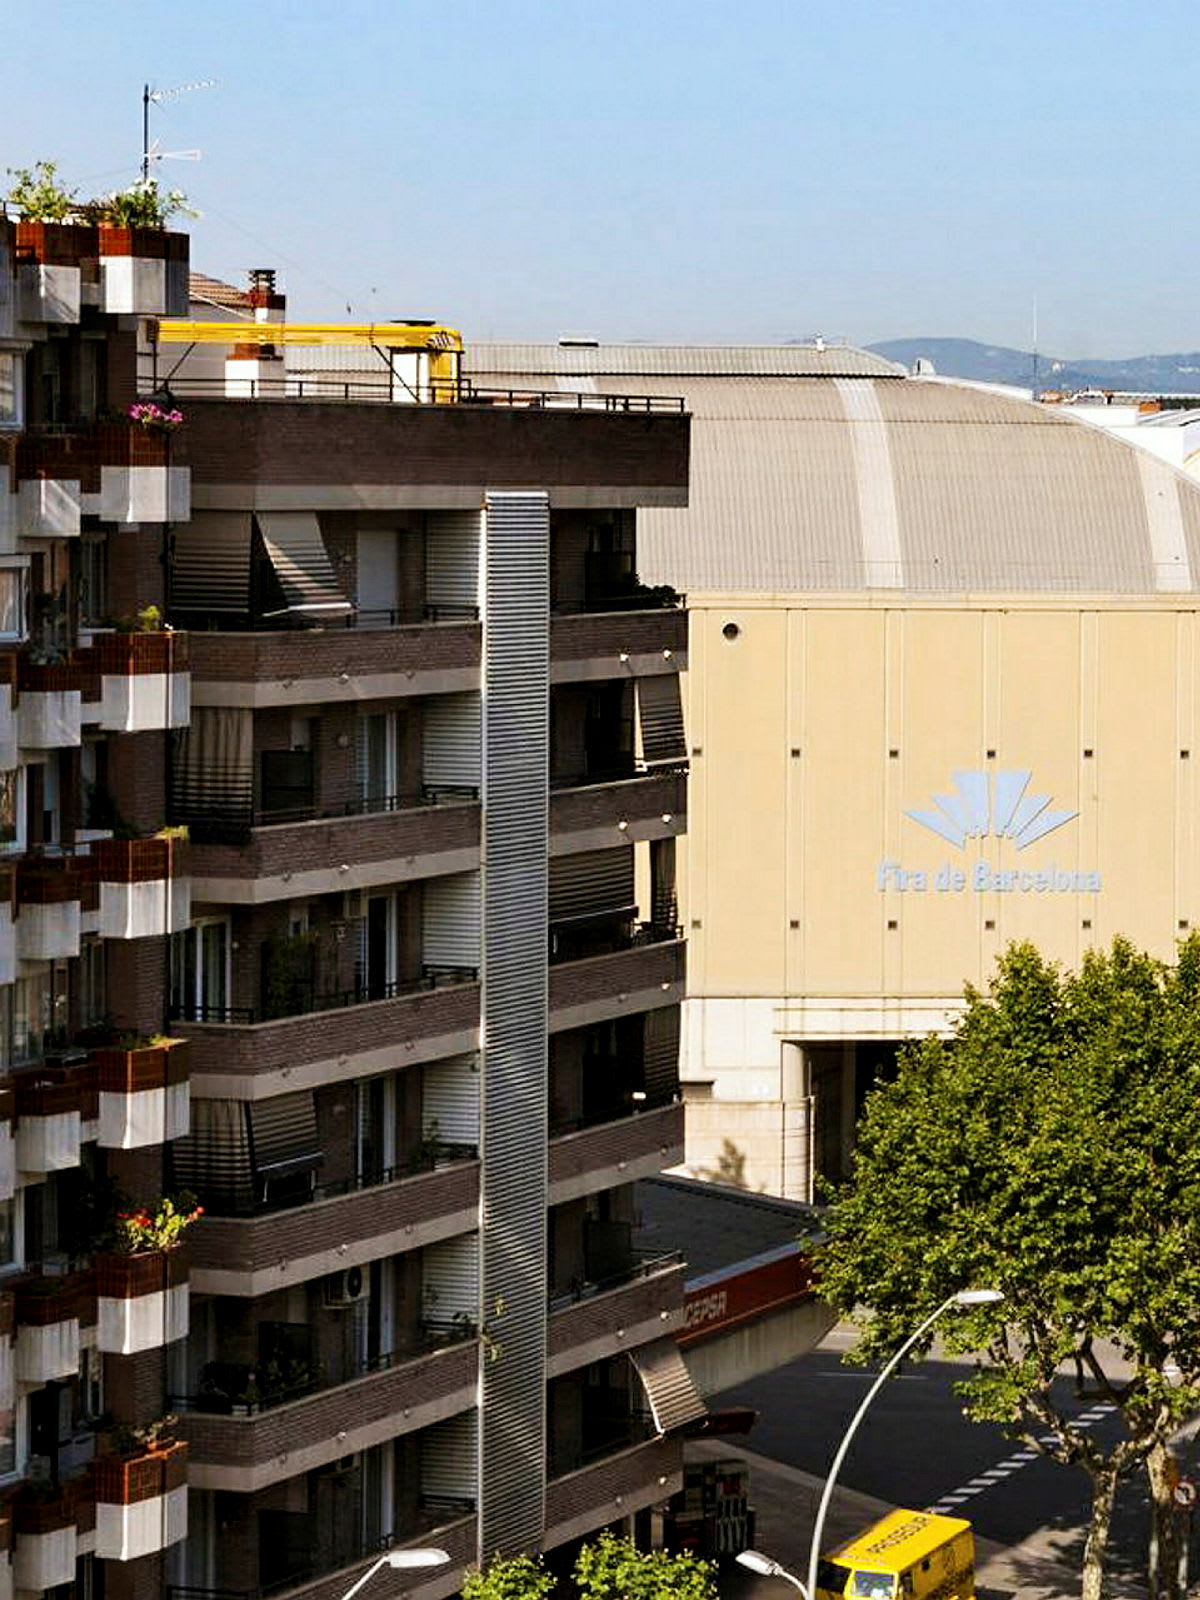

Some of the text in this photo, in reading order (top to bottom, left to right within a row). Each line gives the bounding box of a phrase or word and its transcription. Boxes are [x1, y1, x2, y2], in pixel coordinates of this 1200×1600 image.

[877, 860, 1102, 892] Fira de Barcelona
